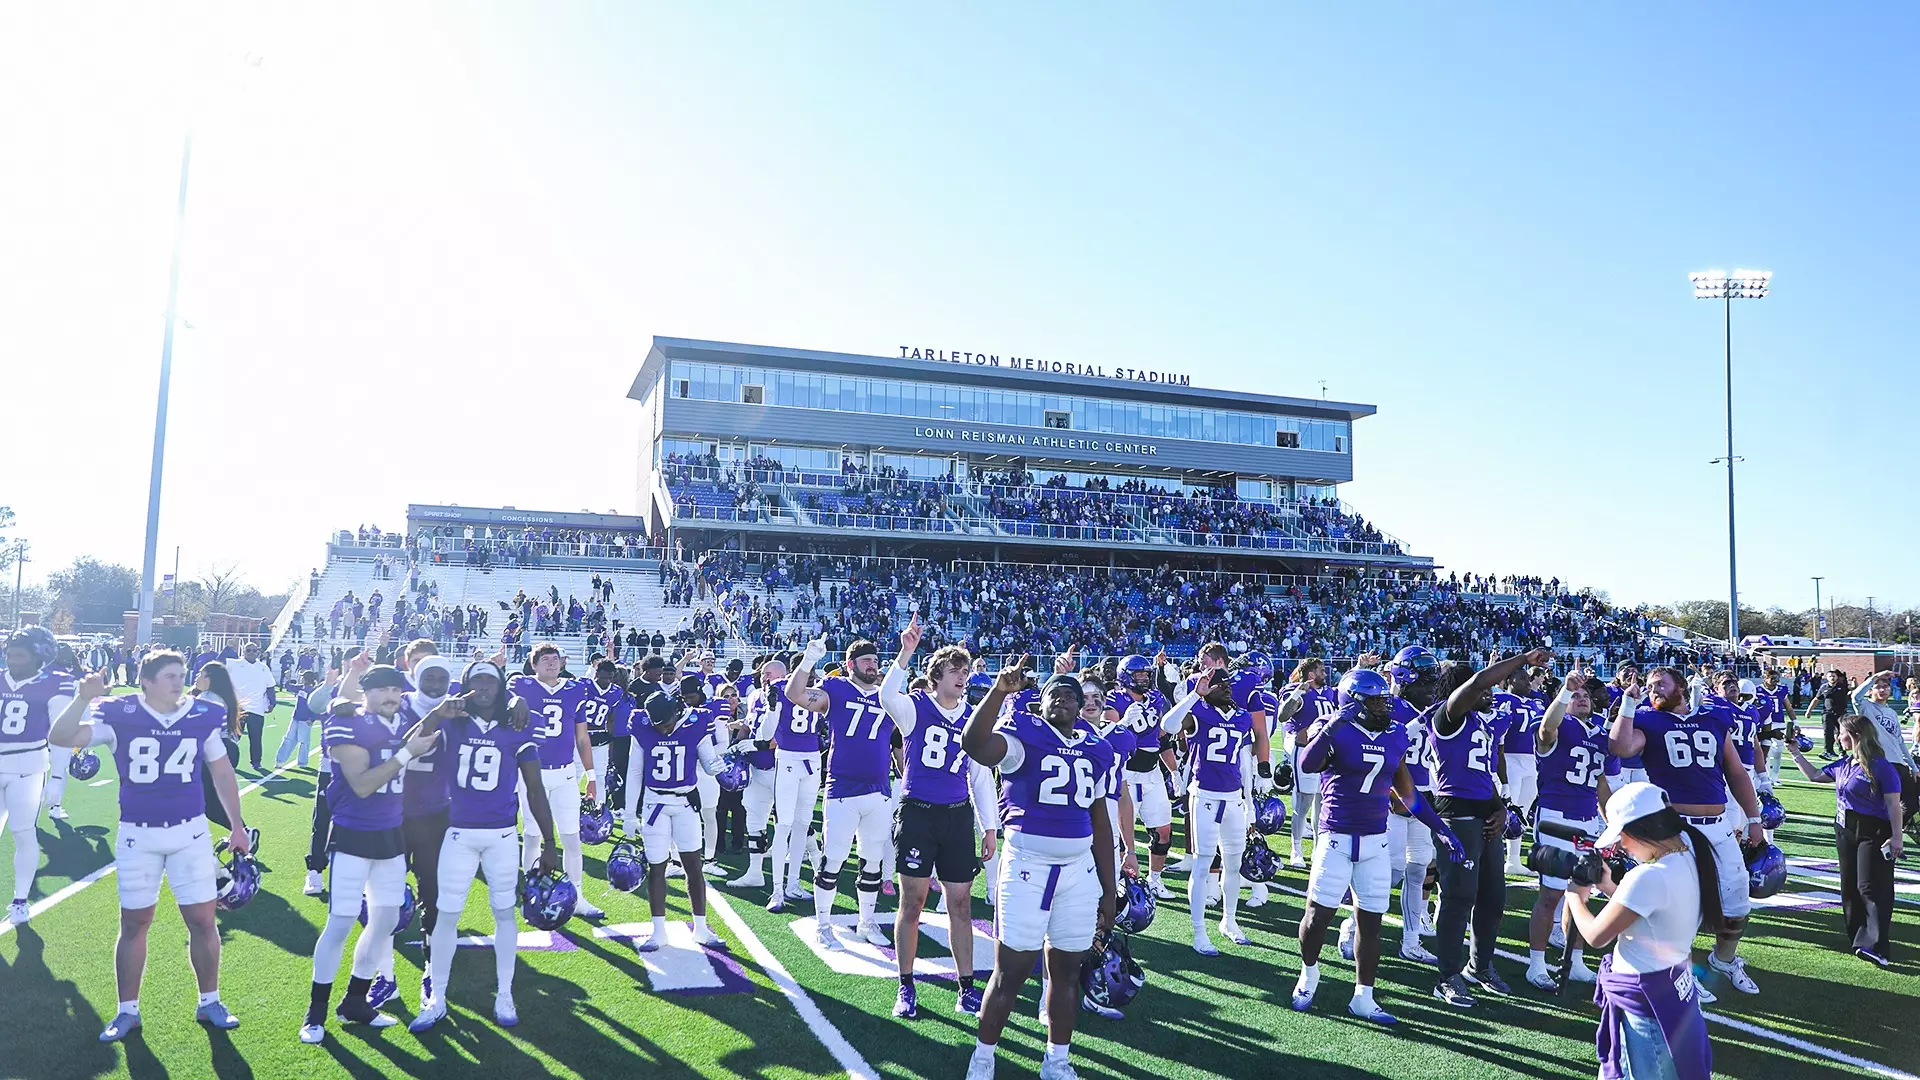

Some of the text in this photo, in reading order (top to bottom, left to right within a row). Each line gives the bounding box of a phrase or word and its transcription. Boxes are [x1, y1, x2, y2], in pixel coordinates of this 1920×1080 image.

[899, 346, 1190, 386] TARLETON MEMORIAL STADIUM
[915, 427, 1157, 455] LONN REISMAN ATHLETIC CENTER
[501, 515, 554, 523] CONCESSIONS
[542, 704, 563, 737] 3
[585, 699, 609, 726] 28
[845, 700, 887, 740] 77
[128, 737, 198, 784] 84
[468, 737, 496, 746] TEXANS
[921, 724, 967, 774] 87
[1056, 747, 1083, 757] TEXANS
[1206, 726, 1243, 765] 27
[1361, 743, 1386, 753] TEXANS
[1663, 730, 1718, 768] 69
[457, 744, 502, 792] 19
[651, 745, 686, 782] 31
[1038, 754, 1096, 809] 26
[1359, 753, 1385, 794] 7
[1565, 746, 1606, 789] 32
